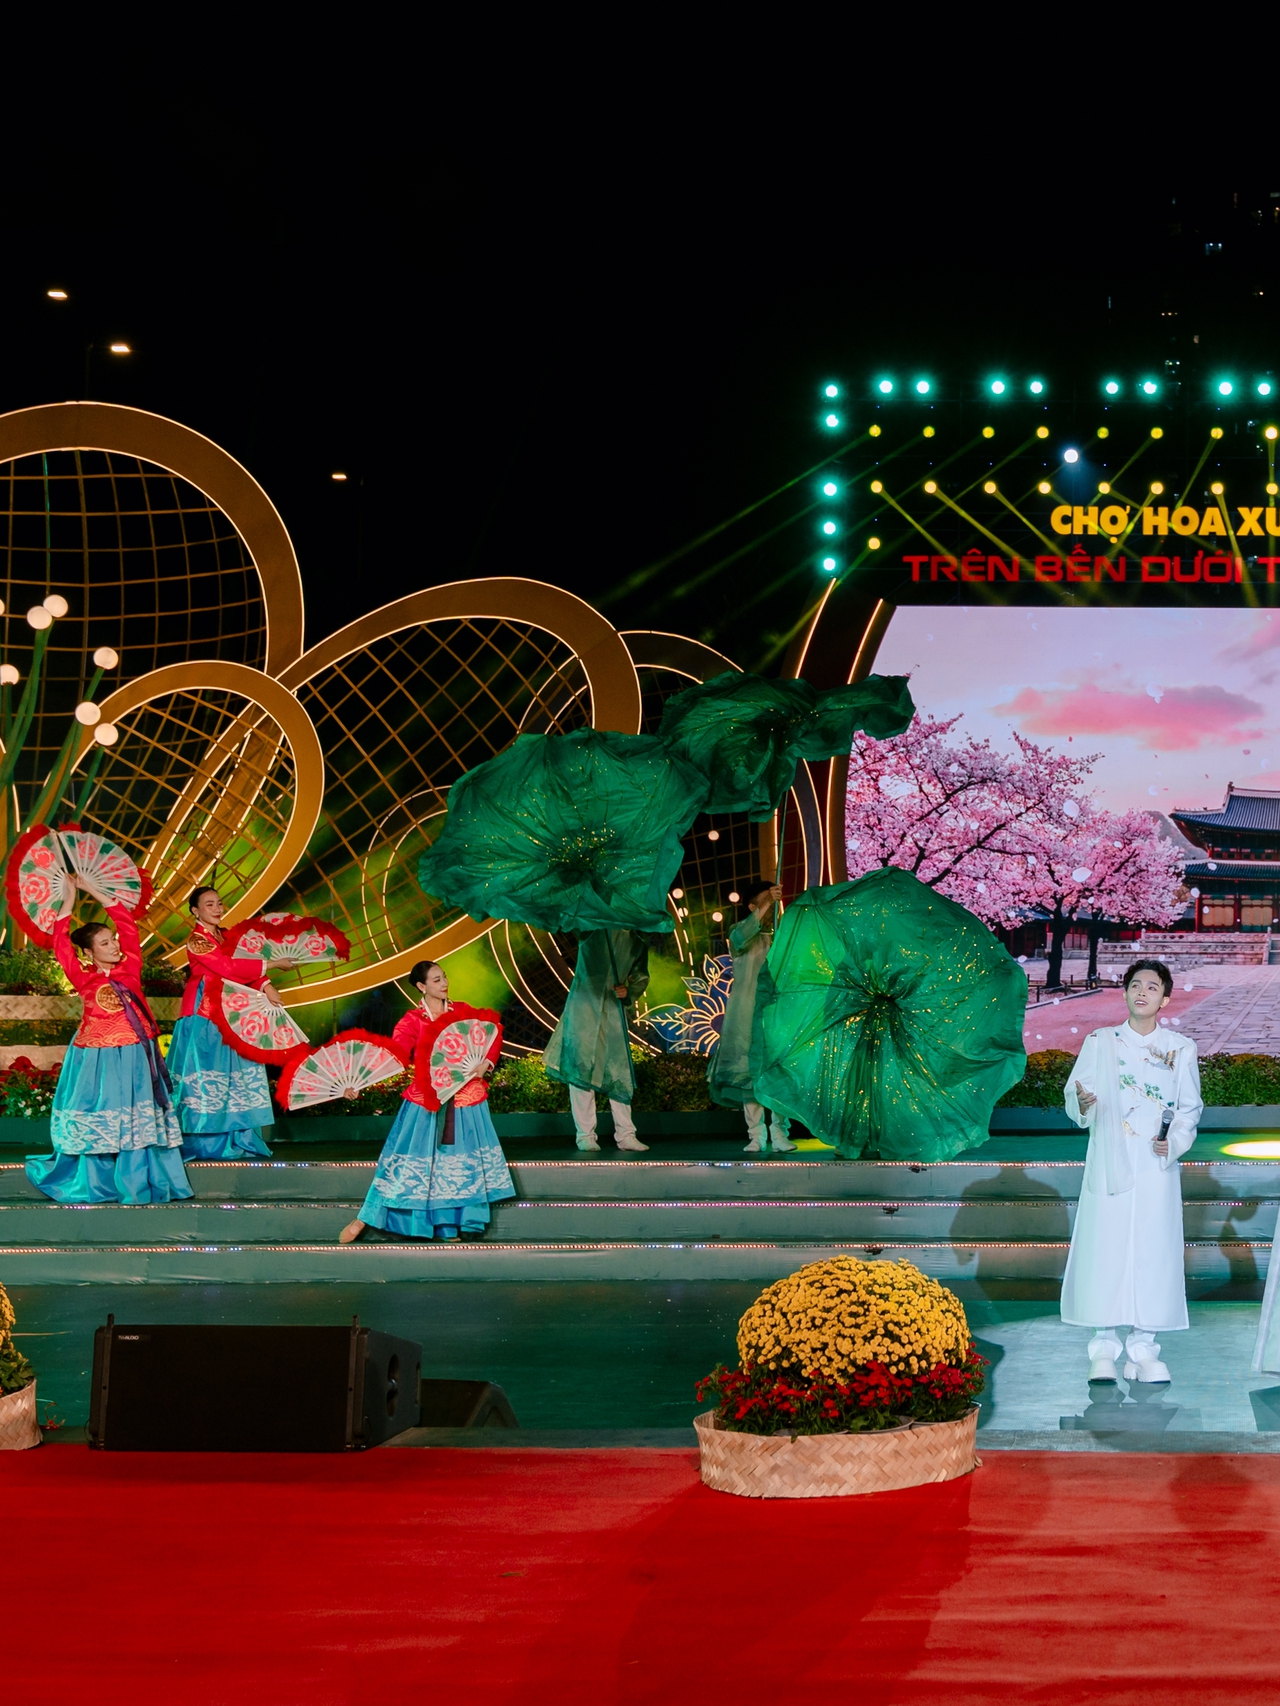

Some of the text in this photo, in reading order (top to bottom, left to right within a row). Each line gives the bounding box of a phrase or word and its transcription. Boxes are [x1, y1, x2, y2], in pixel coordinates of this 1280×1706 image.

[1050, 505, 1130, 543] CHỢ
[1142, 506, 1227, 536] HOA
[903, 548, 1020, 582] TRÊN
[1034, 543, 1126, 582] BẾN
[1141, 549, 1243, 583] DƯỚI
